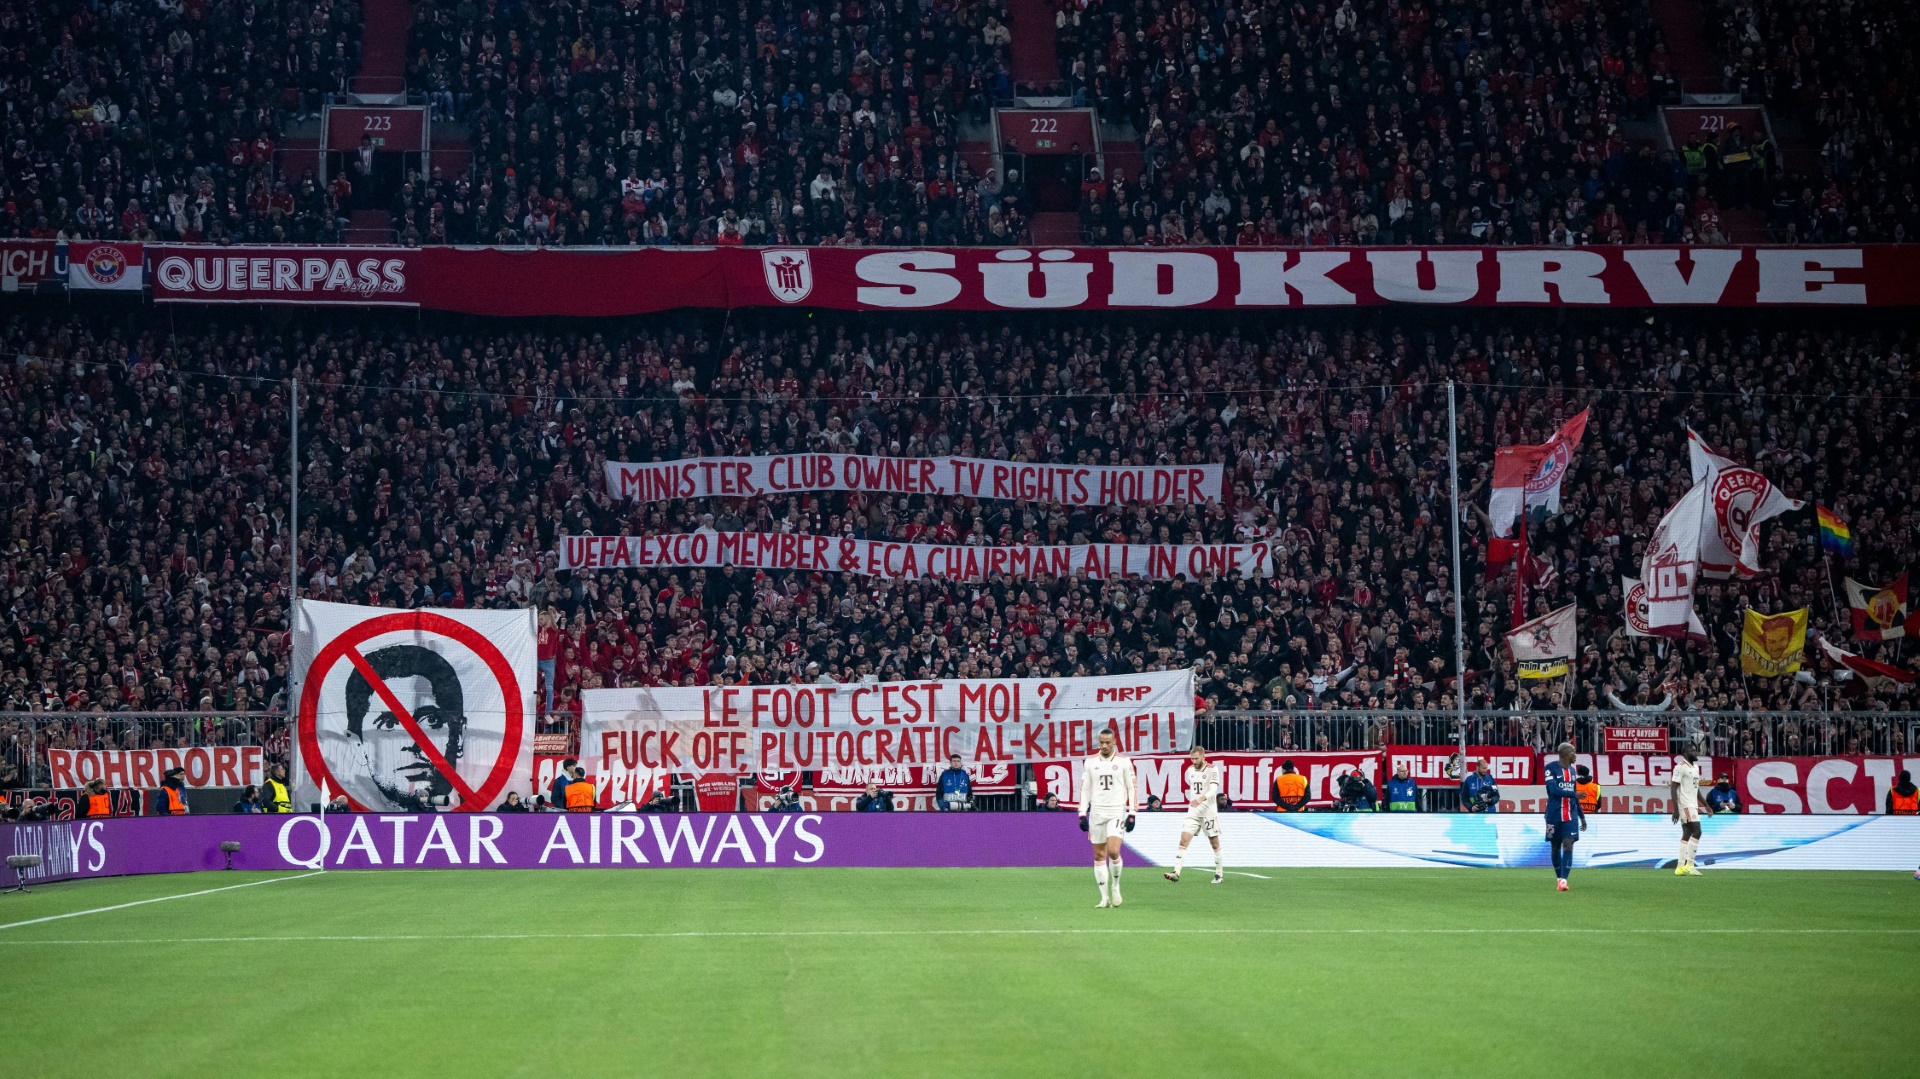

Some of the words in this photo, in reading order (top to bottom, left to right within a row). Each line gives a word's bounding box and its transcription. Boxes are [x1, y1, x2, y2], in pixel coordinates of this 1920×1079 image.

[364, 116, 391, 131] 223
[1030, 118, 1058, 133] 222
[1700, 115, 1724, 130] 221
[158, 256, 405, 292] QUEERPASS
[855, 249, 1867, 308] SÜDKURVE
[620, 462, 764, 500] MINISTER,
[768, 455, 836, 490] CLUB
[843, 456, 945, 495] OWNER,
[950, 459, 985, 495] TV
[993, 465, 1090, 504] RIGHTS
[567, 535, 631, 567] UEFA
[640, 533, 708, 566] EXCO
[716, 533, 830, 571] MEMBER
[838, 537, 861, 571] &
[867, 542, 919, 579] ECA
[927, 546, 1071, 581] CHAIRMAN
[1083, 544, 1140, 579] ALL
[1148, 545, 1177, 579] IN
[1188, 544, 1243, 576] ONE
[1252, 542, 1269, 569] ?
[703, 688, 740, 728] LE
[752, 687, 837, 728] FOOT
[851, 683, 943, 727] C'EST
[959, 682, 1020, 723] MOI
[1037, 682, 1057, 720] ?
[1097, 685, 1152, 703] MRP
[49, 746, 262, 788] ROHRDORF
[601, 730, 682, 770] FUCK
[692, 731, 748, 772] OFF,
[761, 725, 961, 769] PLUTOCRATIC
[277, 815, 508, 870] QATAR
[538, 814, 825, 864] AIRWAYS
[1204, 820, 1215, 830] 27
